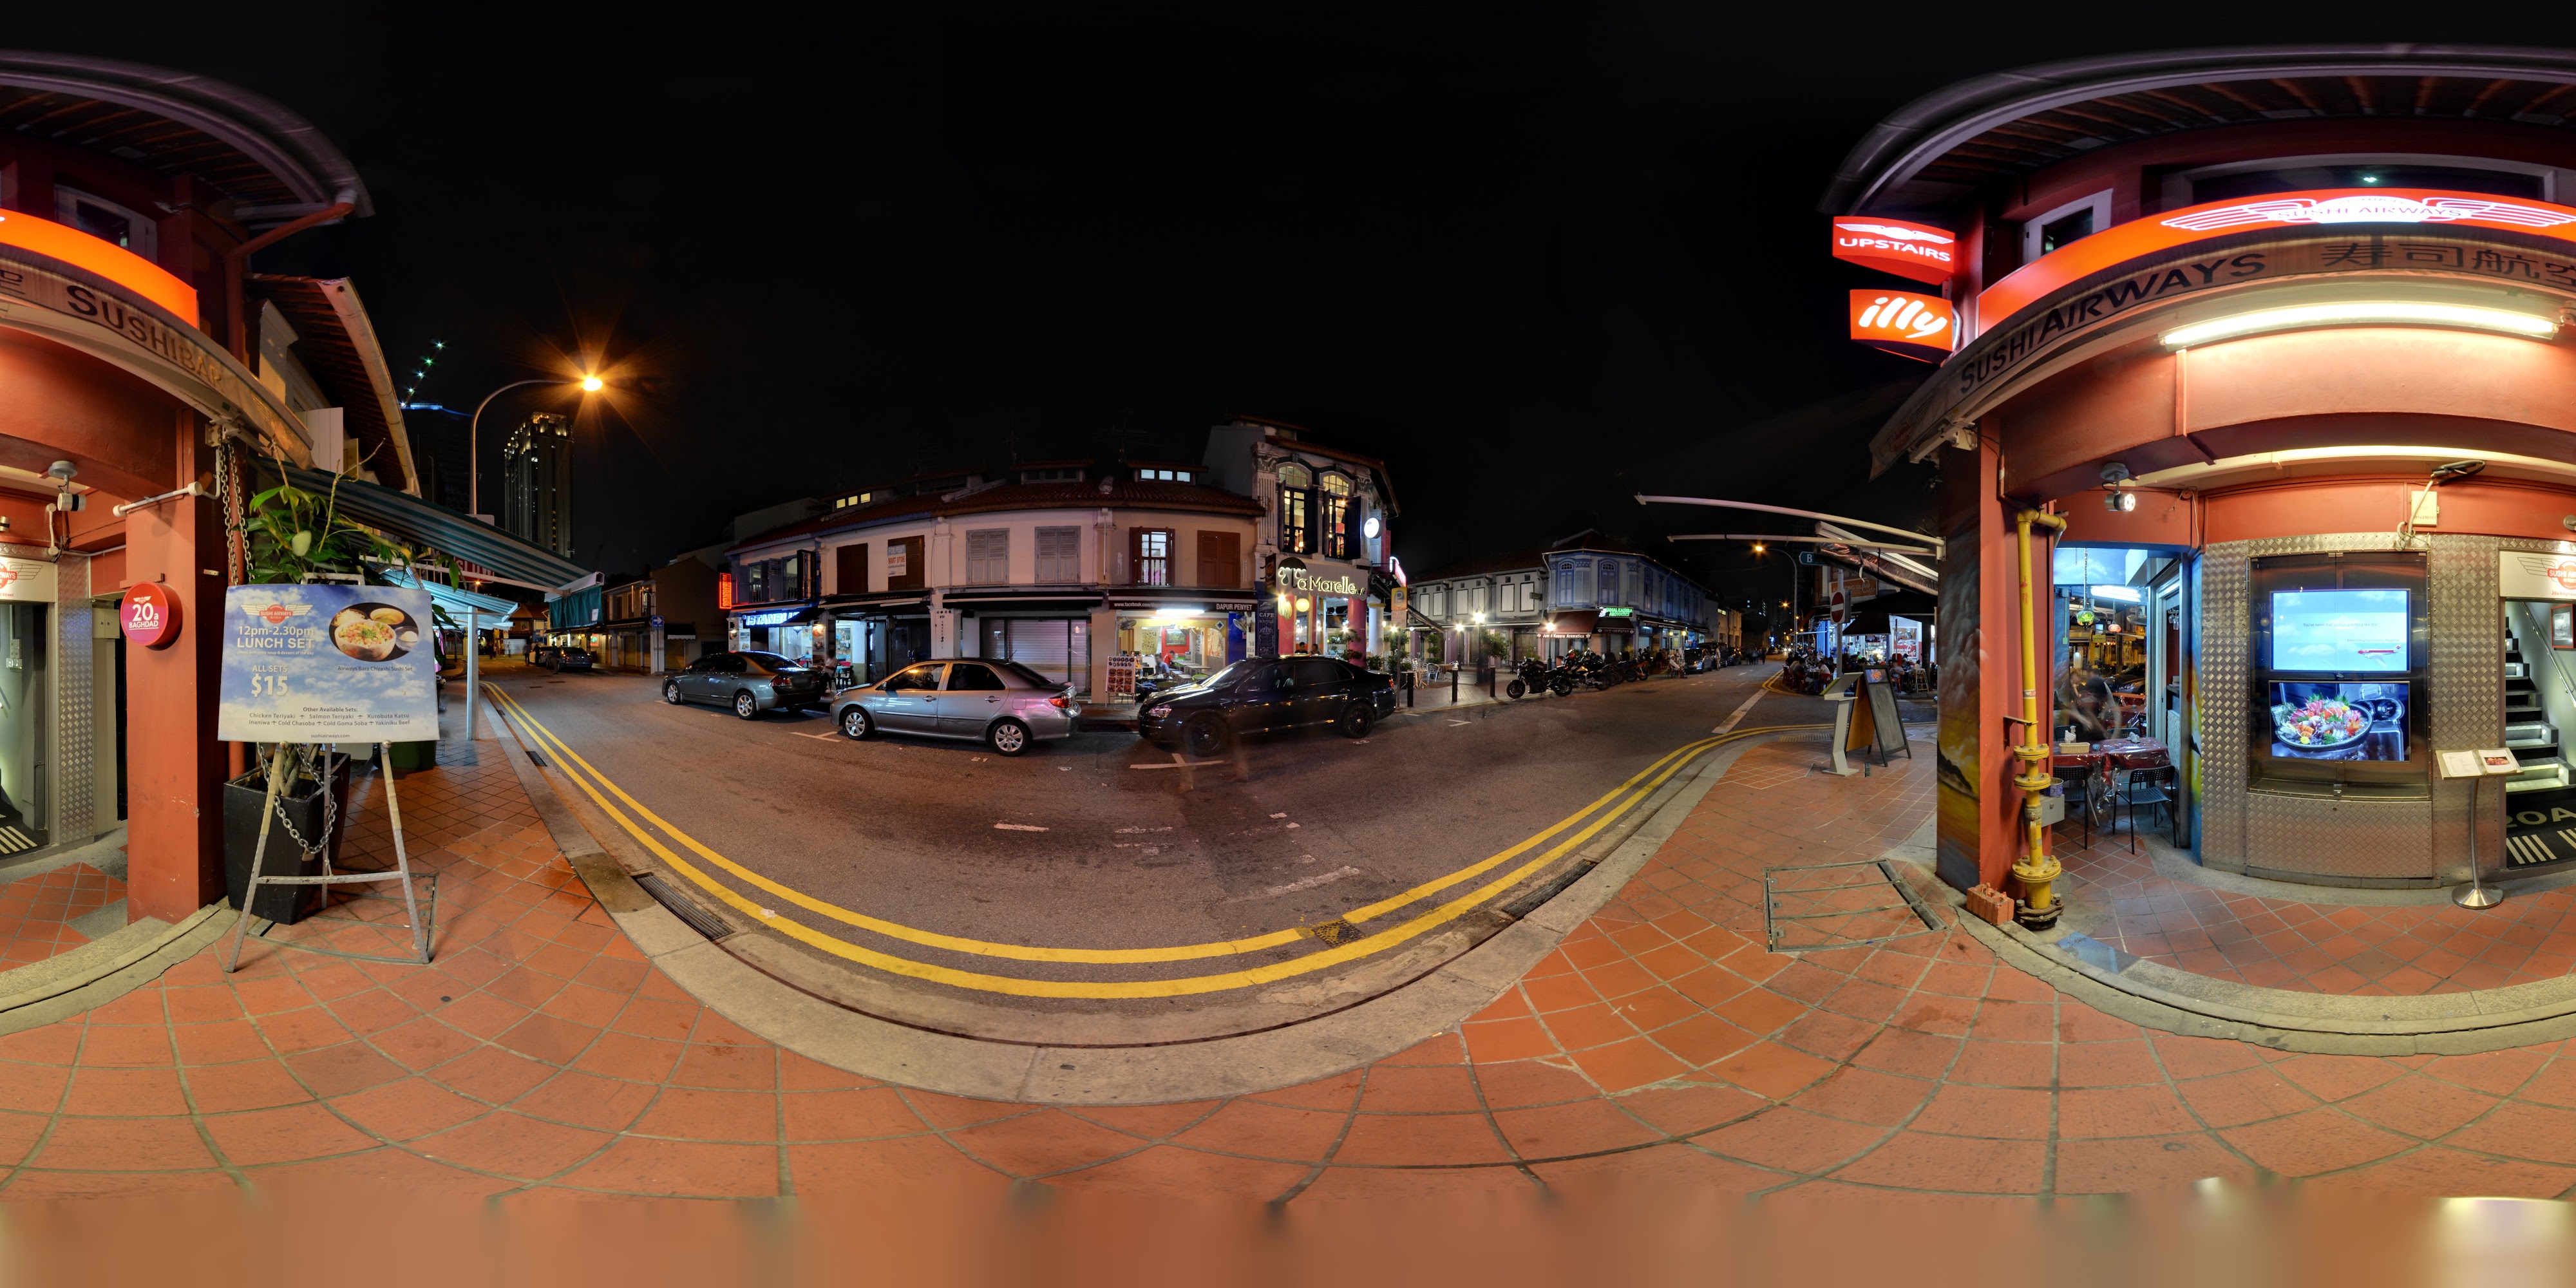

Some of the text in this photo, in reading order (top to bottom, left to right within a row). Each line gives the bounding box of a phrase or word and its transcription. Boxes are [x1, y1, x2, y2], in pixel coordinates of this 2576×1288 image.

[1839, 237, 1951, 261] UPSTAIRS
[1859, 296, 1947, 338] illy
[2548, 569, 2568, 578] SUSHI
[1309, 576, 1357, 594] Marelle
[132, 602, 159, 622] 20a
[129, 620, 159, 629] BAGHDAD
[238, 626, 314, 638] 12pm-2.30pm
[237, 637, 314, 649] LUNCH SET
[251, 673, 288, 697] $15
